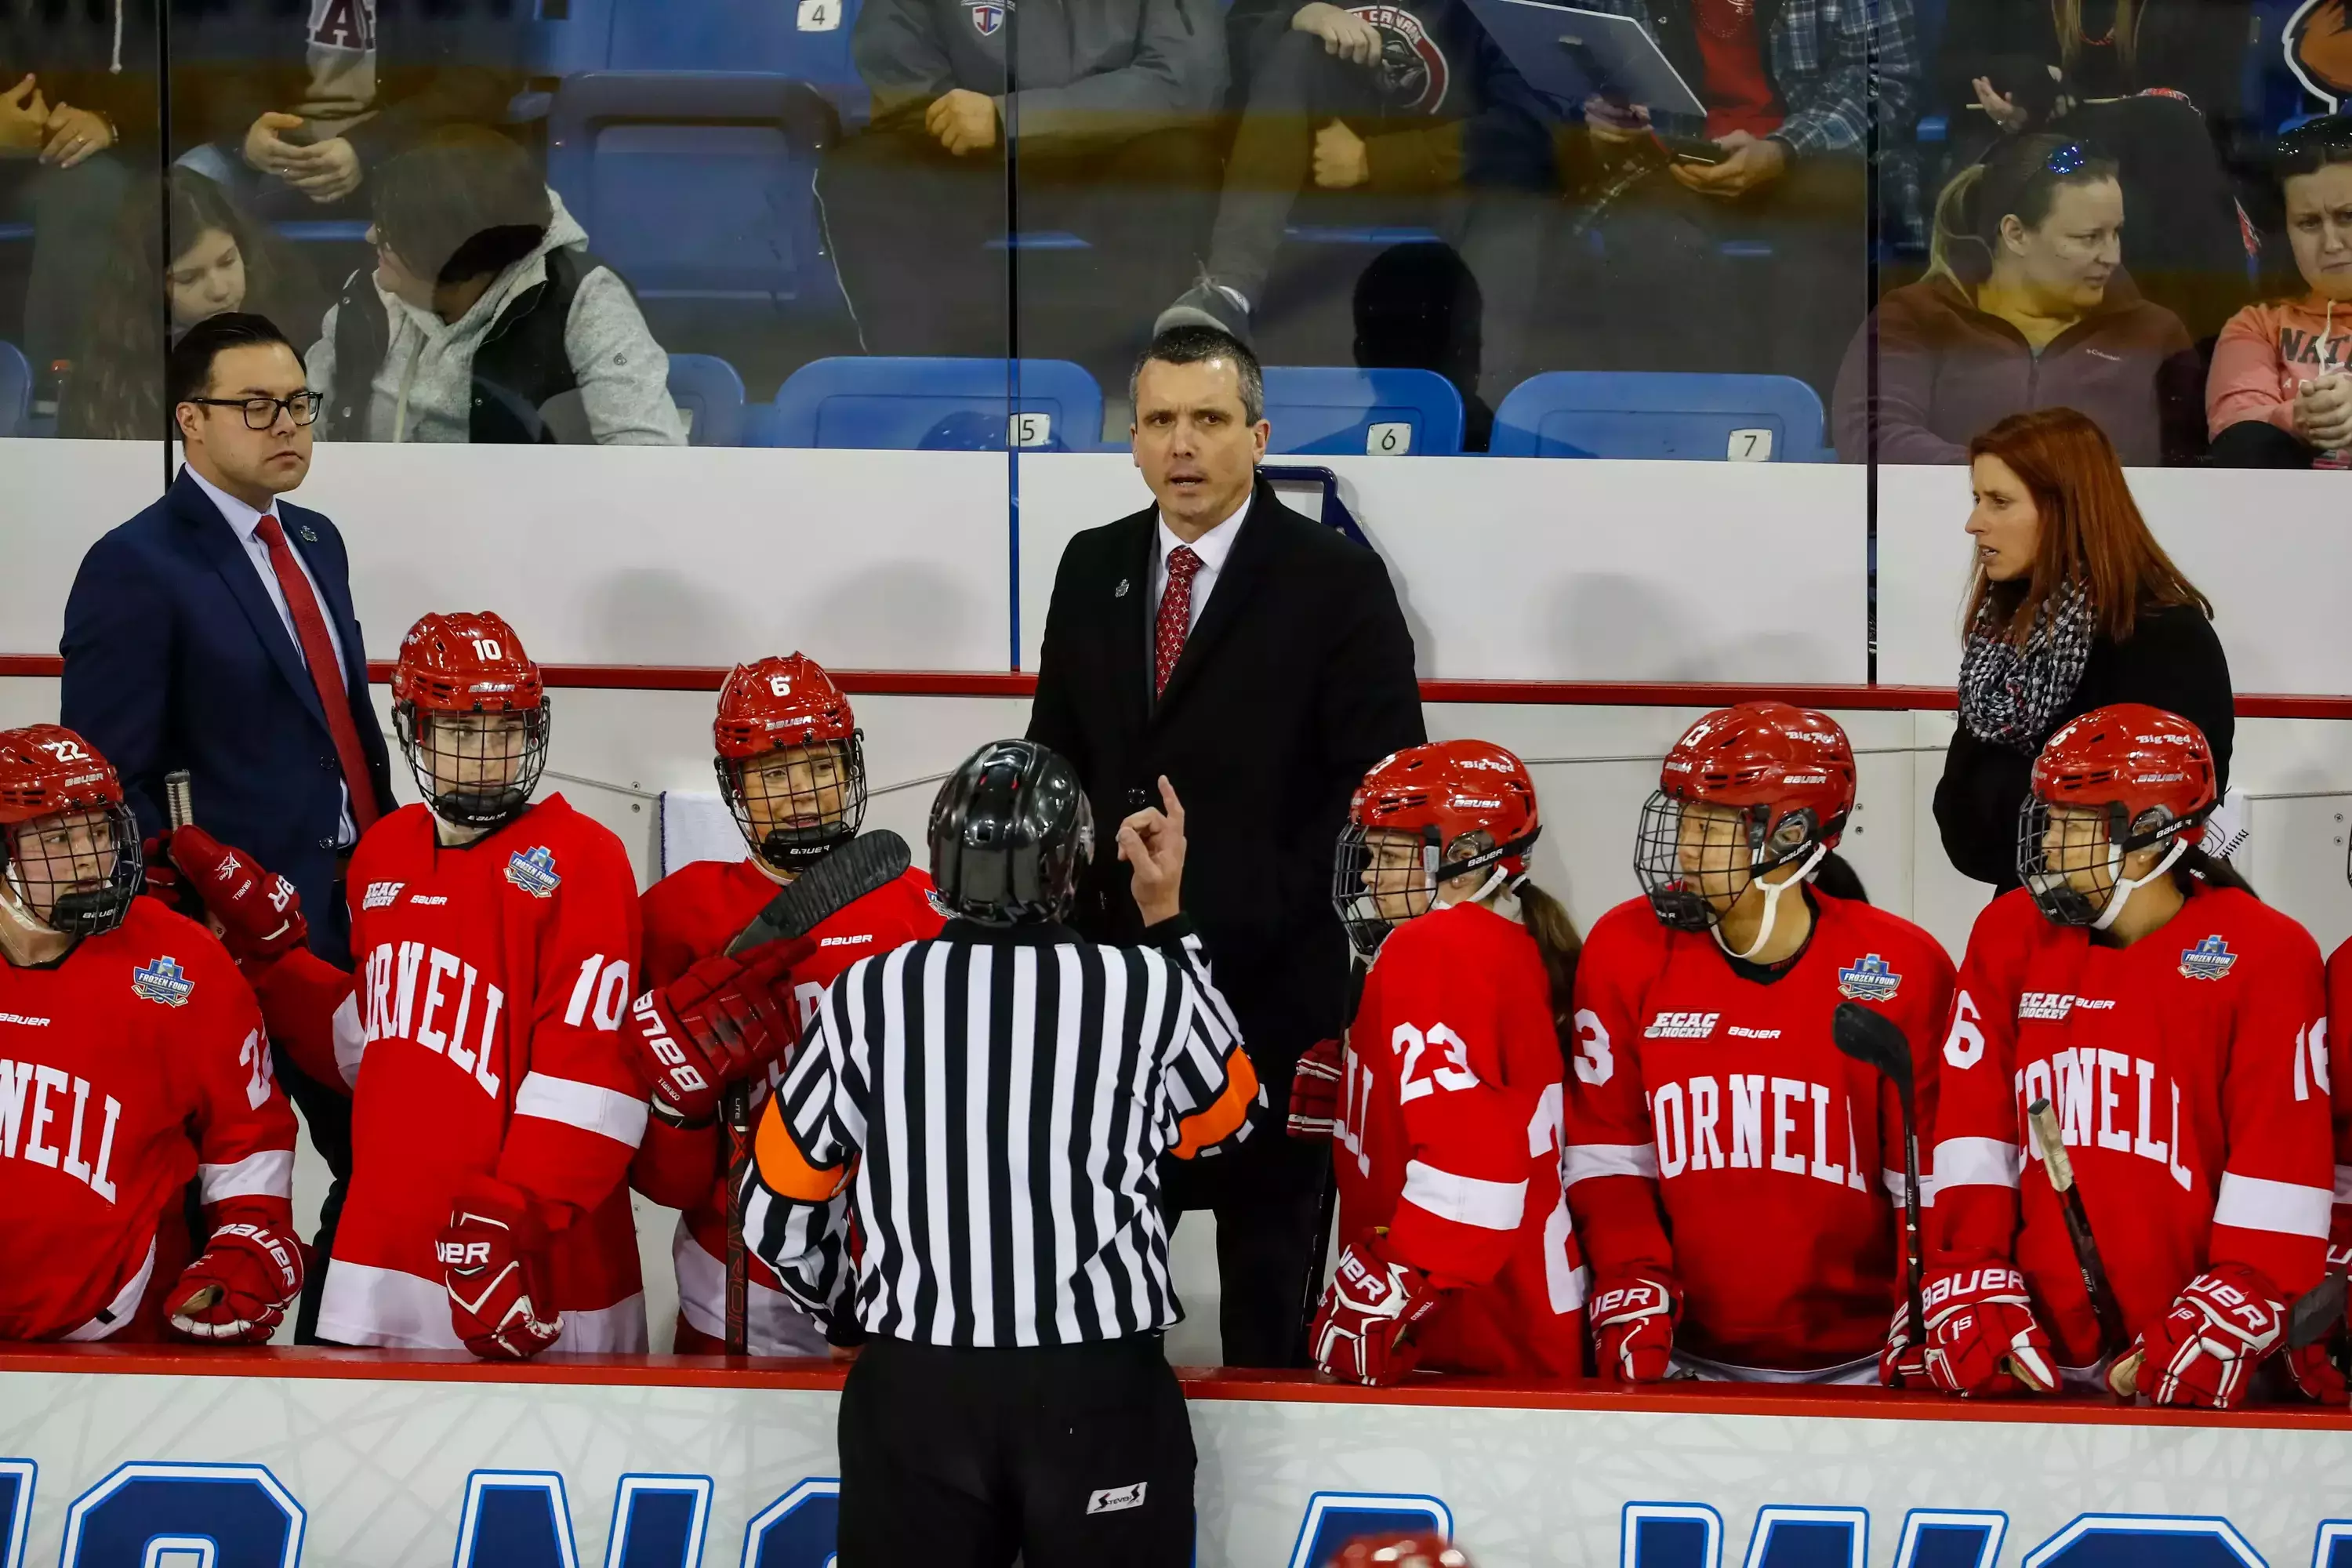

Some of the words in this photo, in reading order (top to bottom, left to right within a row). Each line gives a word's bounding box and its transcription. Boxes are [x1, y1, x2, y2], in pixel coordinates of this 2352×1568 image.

[811, 4, 826, 25] 4
[2281, 328, 2352, 372] NAT
[1021, 419, 1035, 441] 5
[1381, 428, 1396, 450] 6
[1744, 435, 1757, 456] 7
[472, 639, 502, 660] 10
[770, 677, 790, 696] 6
[764, 716, 812, 730] BAUER
[2135, 735, 2163, 744] Big
[2163, 734, 2191, 745] Red
[43, 740, 89, 762] 22
[1460, 759, 1487, 770] Big
[1486, 760, 1515, 773] Red
[65, 772, 104, 787] BAUER
[2137, 773, 2184, 782] BAUER
[1454, 799, 1501, 808] BAUER
[789, 844, 829, 855] BAUER
[1468, 848, 1504, 868] BAUER
[1779, 840, 1813, 862] BAUER
[512, 857, 538, 876] FROZEN
[535, 870, 556, 885] FOUR
[410, 895, 448, 906] BAUER
[820, 934, 873, 946] BAUER
[2185, 953, 2211, 964] FROZEN
[2212, 956, 2230, 965] FOUR
[138, 972, 169, 986] FROZEN
[168, 981, 188, 992] FOUR
[1844, 972, 1875, 983] FROZEN
[1875, 976, 1896, 985] FOUR
[564, 954, 630, 1032] 10
[2020, 993, 2076, 1010] ECAC
[1653, 1013, 1720, 1028] ECAC
[2020, 1007, 2069, 1019] HOCKEY
[1660, 1026, 1712, 1039] HOCKEY
[1727, 1025, 1780, 1040] BAUER
[1944, 989, 1985, 1069] 6
[1574, 1008, 1613, 1087] 3
[1392, 1022, 1480, 1106] 23
[211, 1224, 296, 1288] BAUER
[1922, 1269, 2026, 1315] BAUER
[1410, 1301, 1433, 1320] CORNELL
